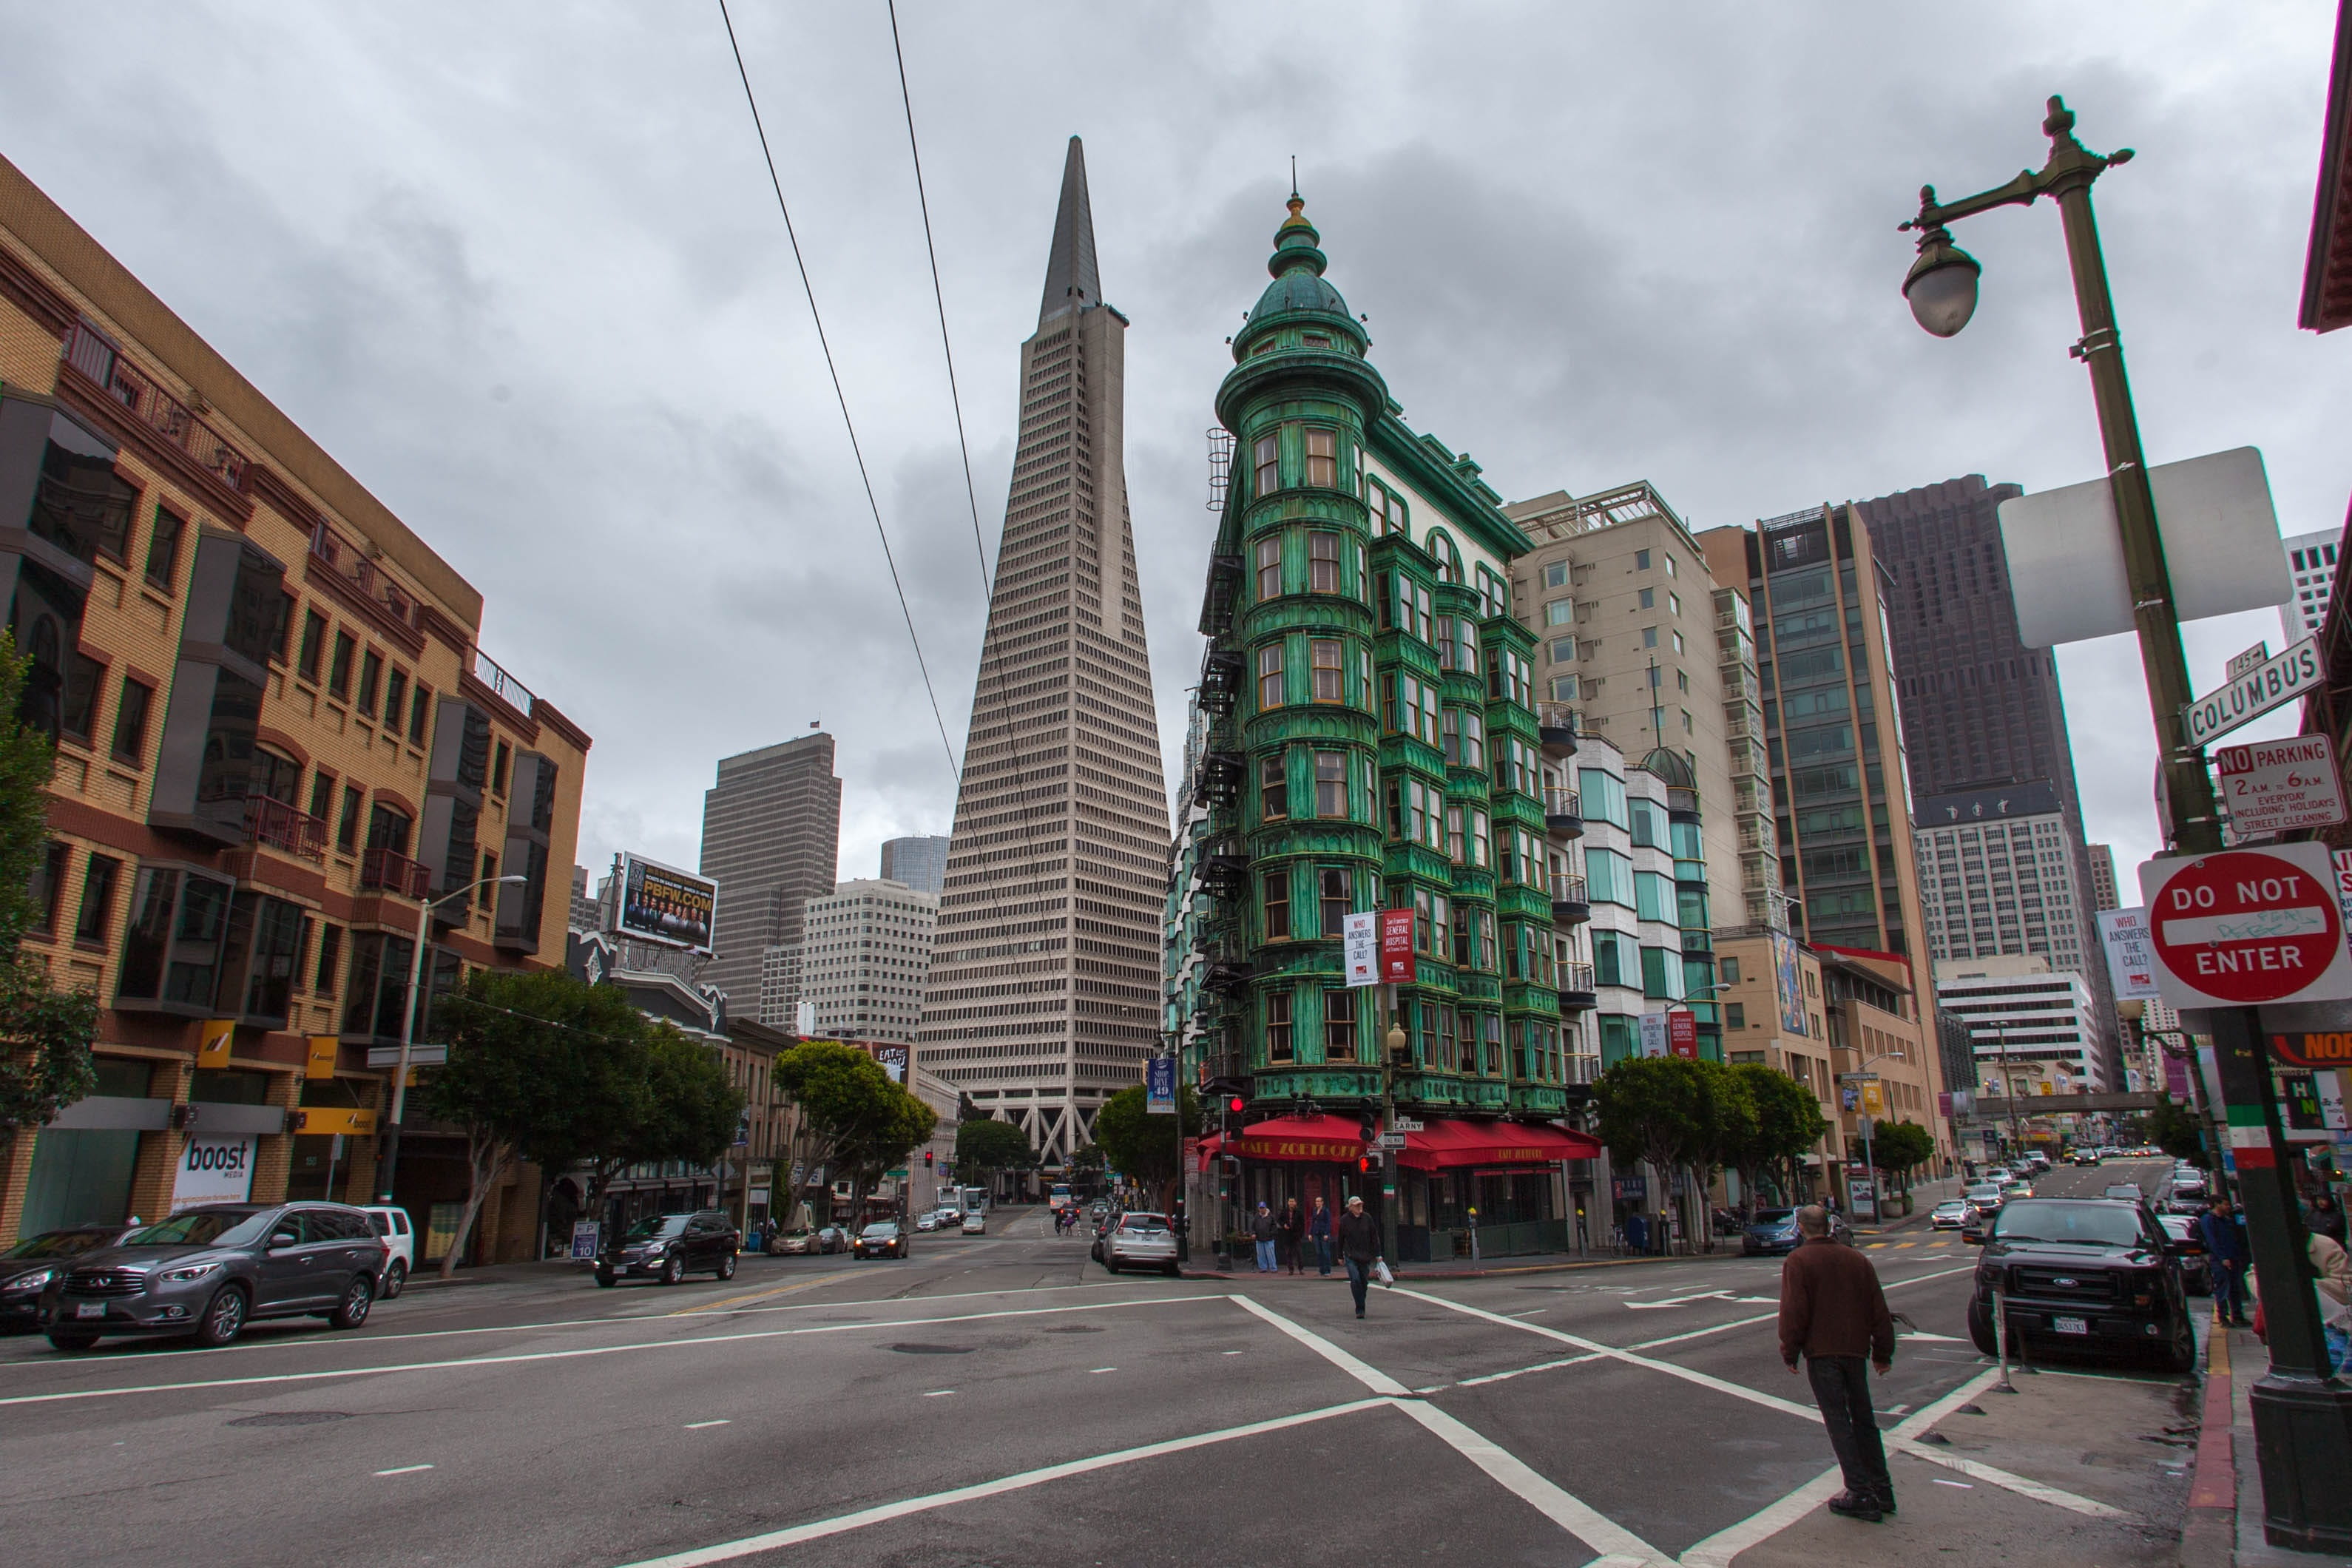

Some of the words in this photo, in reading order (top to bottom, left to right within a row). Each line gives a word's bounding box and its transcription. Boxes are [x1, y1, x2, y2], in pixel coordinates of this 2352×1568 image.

[2192, 649, 2315, 737] COLUMBUS
[2221, 748, 2250, 773] NO
[2257, 743, 2325, 767] PARKING
[2234, 779, 2248, 796] 2
[2251, 784, 2271, 794] A.M.
[2288, 771, 2301, 788] 6
[2304, 777, 2325, 786] A.M.
[2257, 791, 2306, 806] EVERYDAY
[2234, 804, 2285, 819] INCLUDING
[2289, 798, 2336, 811] HOLIDAYS
[2244, 817, 2279, 831] STREET
[2283, 812, 2332, 825] CLEANING
[643, 880, 712, 912] PBFW.COM
[2172, 885, 2216, 910] DO
[2236, 876, 2300, 904] NOT
[1354, 919, 1365, 929] WHO
[2115, 916, 2137, 928] WHO
[1348, 928, 1371, 941] ANSWERS
[1385, 925, 1408, 936] GENERAL
[2109, 927, 2150, 942] ANSWERS
[1355, 939, 1365, 949] THE
[1385, 936, 1409, 946] HOSPITAL
[2123, 941, 2142, 953] THE
[1353, 950, 1367, 960] CALL?
[2122, 953, 2148, 967] CALL?
[2195, 945, 2304, 975] ENTER
[879, 1047, 896, 1061] EAT
[1154, 1077, 1169, 1087] DINE
[1394, 1122, 1422, 1130] EARNY
[187, 1138, 248, 1171] boost
[1240, 1141, 1272, 1155] CAFE
